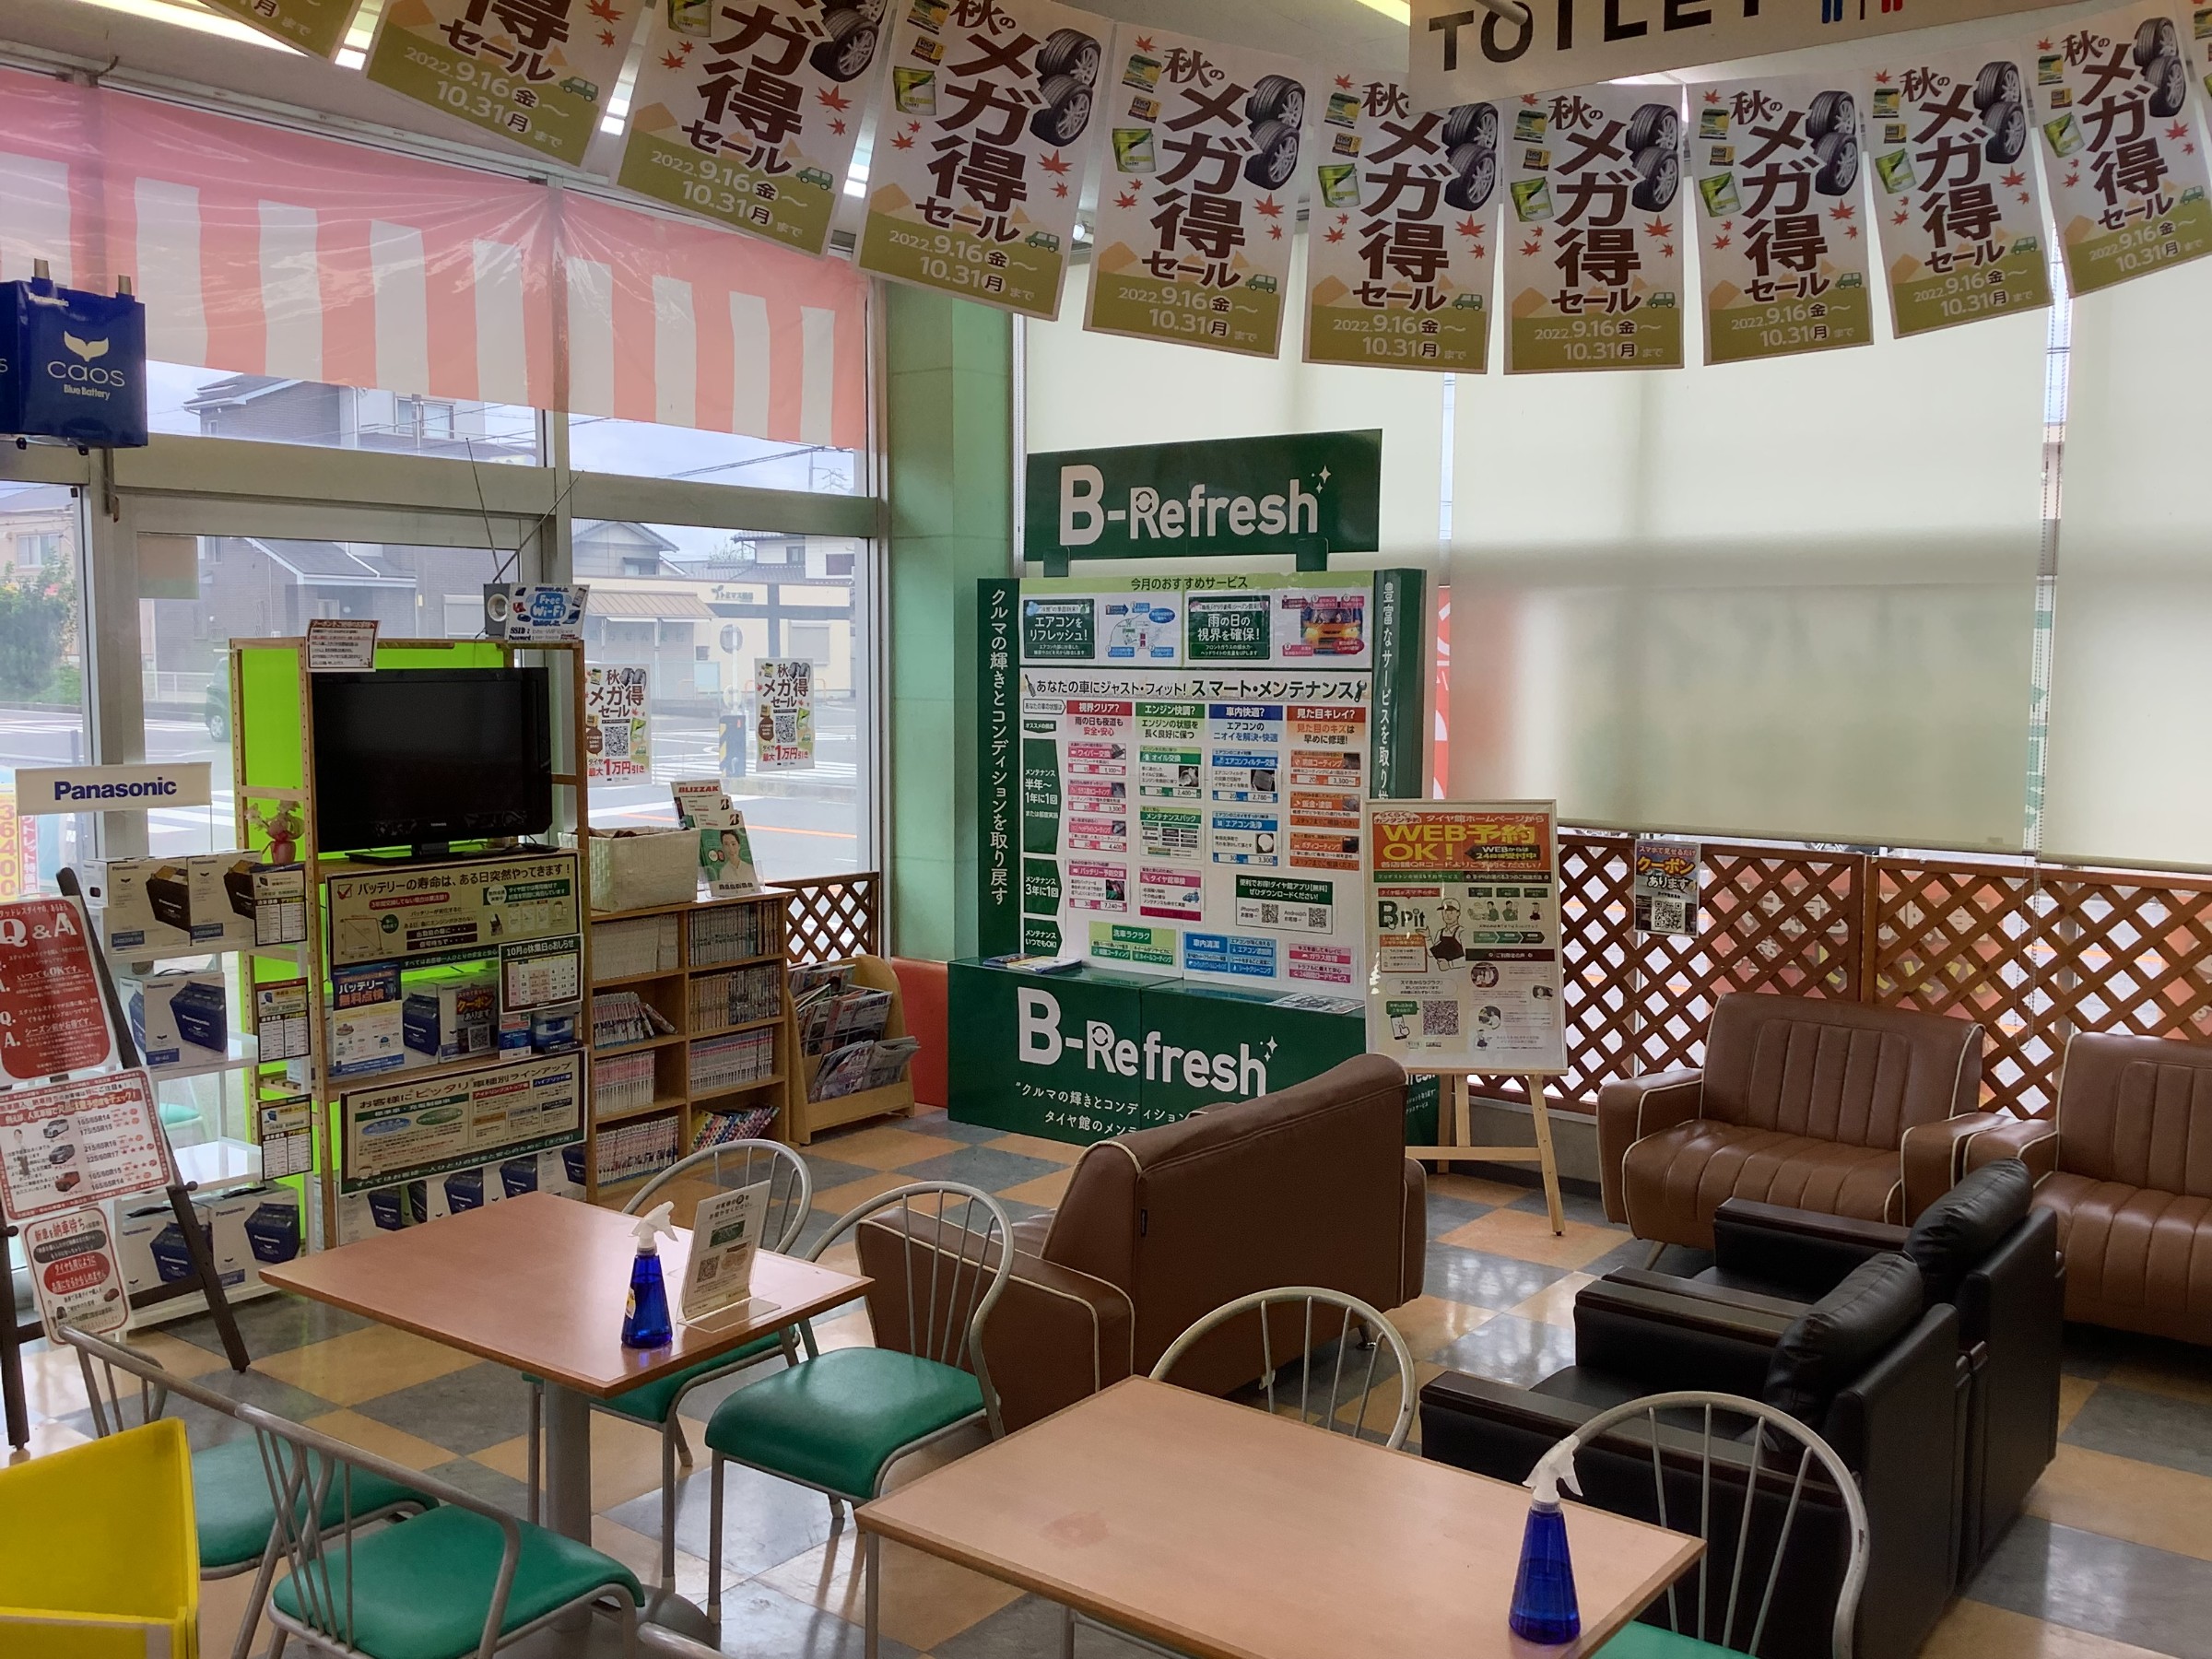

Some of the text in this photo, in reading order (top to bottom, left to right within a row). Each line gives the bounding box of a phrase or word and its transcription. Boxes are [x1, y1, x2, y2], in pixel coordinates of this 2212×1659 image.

[950, 0, 1017, 36] 秋の
[440, 18, 557, 83] セール
[2061, 30, 2111, 66] 秋の
[1161, 47, 1225, 88] 秋の
[1899, 66, 1950, 102] 秋の
[1548, 95, 1604, 130] 秋の
[1730, 89, 1783, 125] 秋の
[927, 32, 1042, 213] メガ得
[2077, 43, 2168, 206] メガ得
[681, 119, 792, 174] セール
[1150, 82, 1253, 260] メガ得
[1912, 84, 2002, 249] メガ得
[1359, 112, 1453, 284] メガ得
[1554, 119, 1641, 288] メガ得
[1739, 111, 1828, 276] メガ得
[915, 196, 1021, 242] セール
[2098, 193, 2174, 230] セール
[1924, 240, 2005, 274] セール
[1142, 251, 1241, 289] セール
[1352, 280, 1447, 312] セール
[1744, 272, 1830, 302] セール
[1551, 288, 1641, 315] セール
[64, 384, 111, 401] Blue Battery
[1059, 464, 1318, 547] B-Refresh
[1131, 576, 1248, 591] 今月のおすすめサービス
[540, 594, 561, 606] Free
[533, 605, 564, 618] Wi-Fi
[1207, 614, 1250, 627] 雨の日の
[1035, 617, 1083, 628] エアコンを
[1030, 629, 1088, 641] リフレッシュ!
[1197, 628, 1260, 641] 視界を確保!
[589, 686, 643, 707] メガ得
[762, 678, 808, 697] メガ得
[1037, 679, 1186, 694] あなたの車にジャスト・フィット!
[1192, 679, 1356, 699] スマート・メンテナンス
[598, 705, 629, 718] セール
[771, 696, 797, 708] セール
[1079, 702, 1119, 712] 視界クリア?
[1298, 709, 1356, 720] 見た目キレイ?
[1142, 720, 1198, 730] エンジンの状態を
[1227, 722, 1265, 731] エアコンの
[1298, 724, 1355, 735] 見た目のキズは
[989, 588, 1009, 906] クルマの輝きとコンディションを取り戻す
[1025, 769, 1055, 777] メンテナンス
[54, 777, 178, 801] Panasonic
[678, 785, 719, 794] BLIZZAK
[1382, 824, 1535, 844] WEB予約
[1383, 843, 1453, 861] OK!
[1638, 856, 1696, 874] クーポン
[1025, 877, 1056, 885] メンテナンス
[1025, 884, 1059, 898] 3年に1回
[1647, 877, 1688, 889] あります
[1025, 930, 1057, 939] メンテナンス
[339, 980, 384, 994] バッテリー
[5, 1032, 21, 1048] A.
[1017, 986, 1267, 1097] B-Refresh
[216, 1206, 245, 1218] Panasonic
